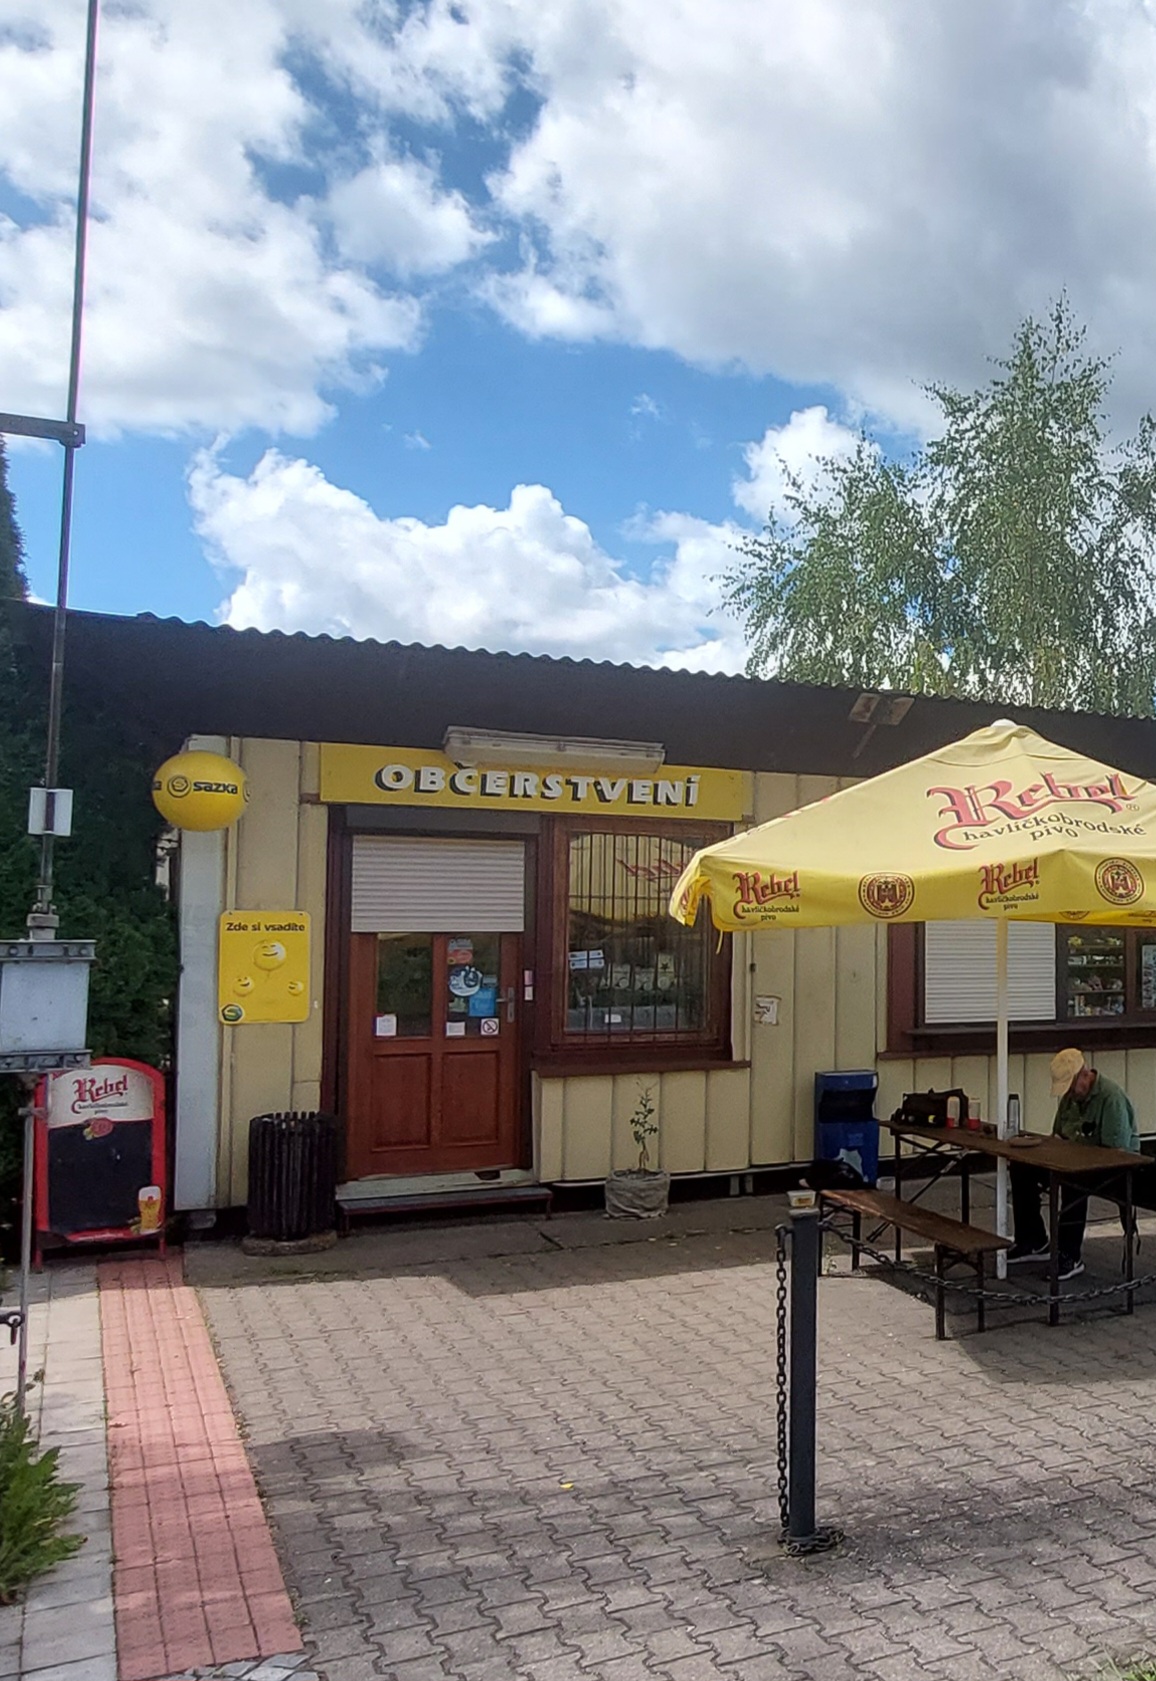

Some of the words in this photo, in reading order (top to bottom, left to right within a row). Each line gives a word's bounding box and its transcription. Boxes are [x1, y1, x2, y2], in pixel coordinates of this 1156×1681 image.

[374, 762, 701, 807] OBČERSTVENÍ
[926, 771, 1138, 850] Rebel
[1029, 825, 1079, 841] pivo
[732, 870, 801, 919] Rebel
[977, 856, 1039, 910] Rebel
[226, 922, 248, 932] Zde
[251, 922, 261, 932] si
[71, 1073, 129, 1115] Rebel
